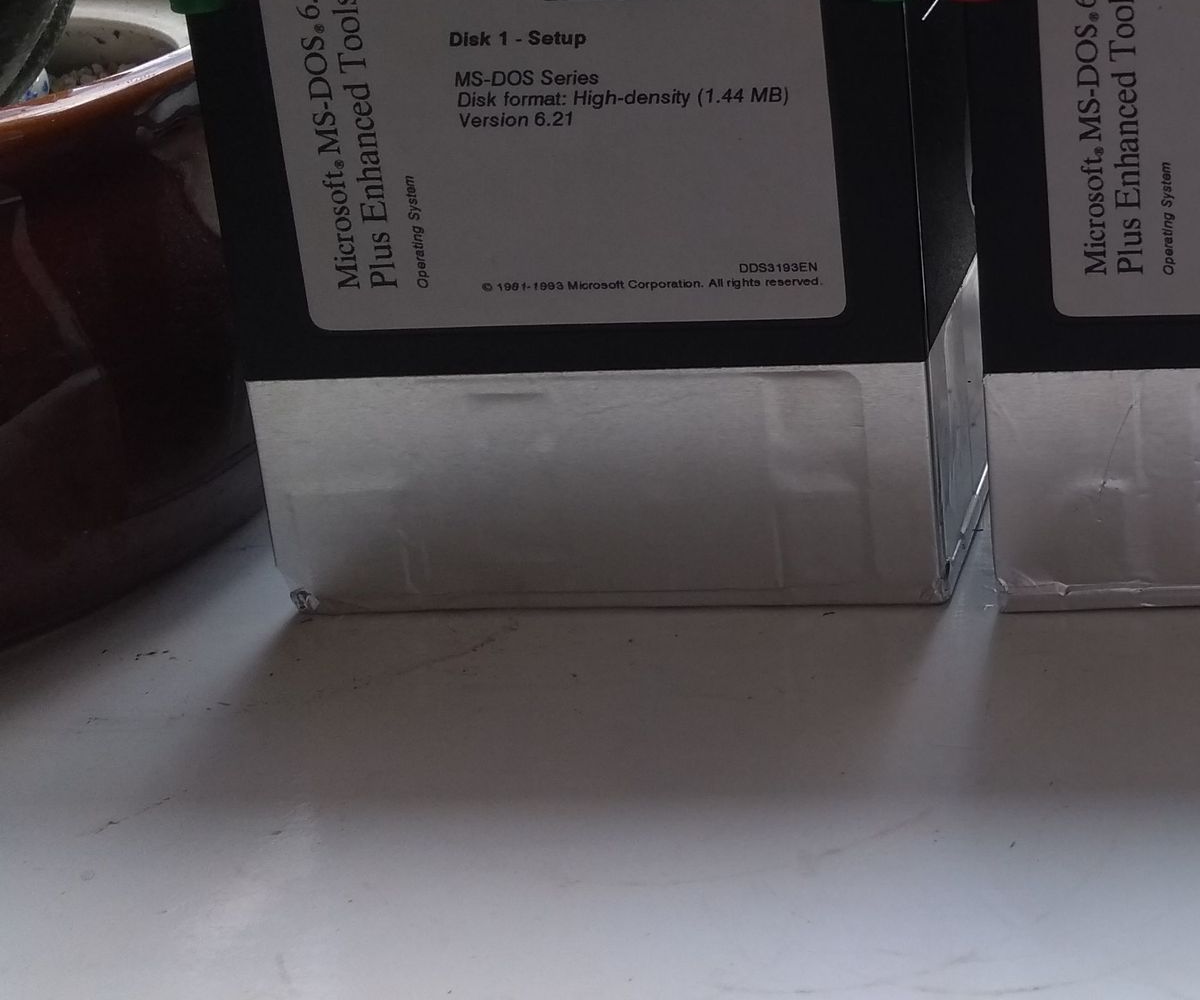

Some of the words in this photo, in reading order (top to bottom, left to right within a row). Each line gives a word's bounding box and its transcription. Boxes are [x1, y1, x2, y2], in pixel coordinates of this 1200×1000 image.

[448, 30, 492, 48] Disk
[527, 29, 588, 50] Setup
[454, 69, 535, 88] MS-DOS
[540, 68, 600, 86] Series
[456, 90, 497, 108] Disk
[503, 90, 568, 107] format:
[573, 88, 692, 110] High-density
[697, 87, 745, 108] (1.44
[750, 86, 789, 107] MB)
[458, 111, 529, 129] Version
[533, 110, 573, 127] 6.21
[1109, 70, 1142, 210] Enhanced
[341, 81, 389, 224] Enhanced
[404, 175, 422, 222] System
[1160, 161, 1176, 209] System
[368, 231, 399, 289] Plus
[411, 225, 430, 289] Operating
[1116, 217, 1144, 275] Plus
[1161, 211, 1177, 276] Operating
[567, 279, 626, 291] Microsoft
[627, 278, 705, 292] Corporation.
[708, 277, 724, 289] All
[726, 277, 761, 290] rights
[764, 276, 824, 287] reserved.
[738, 261, 818, 274] DDS3193EN
